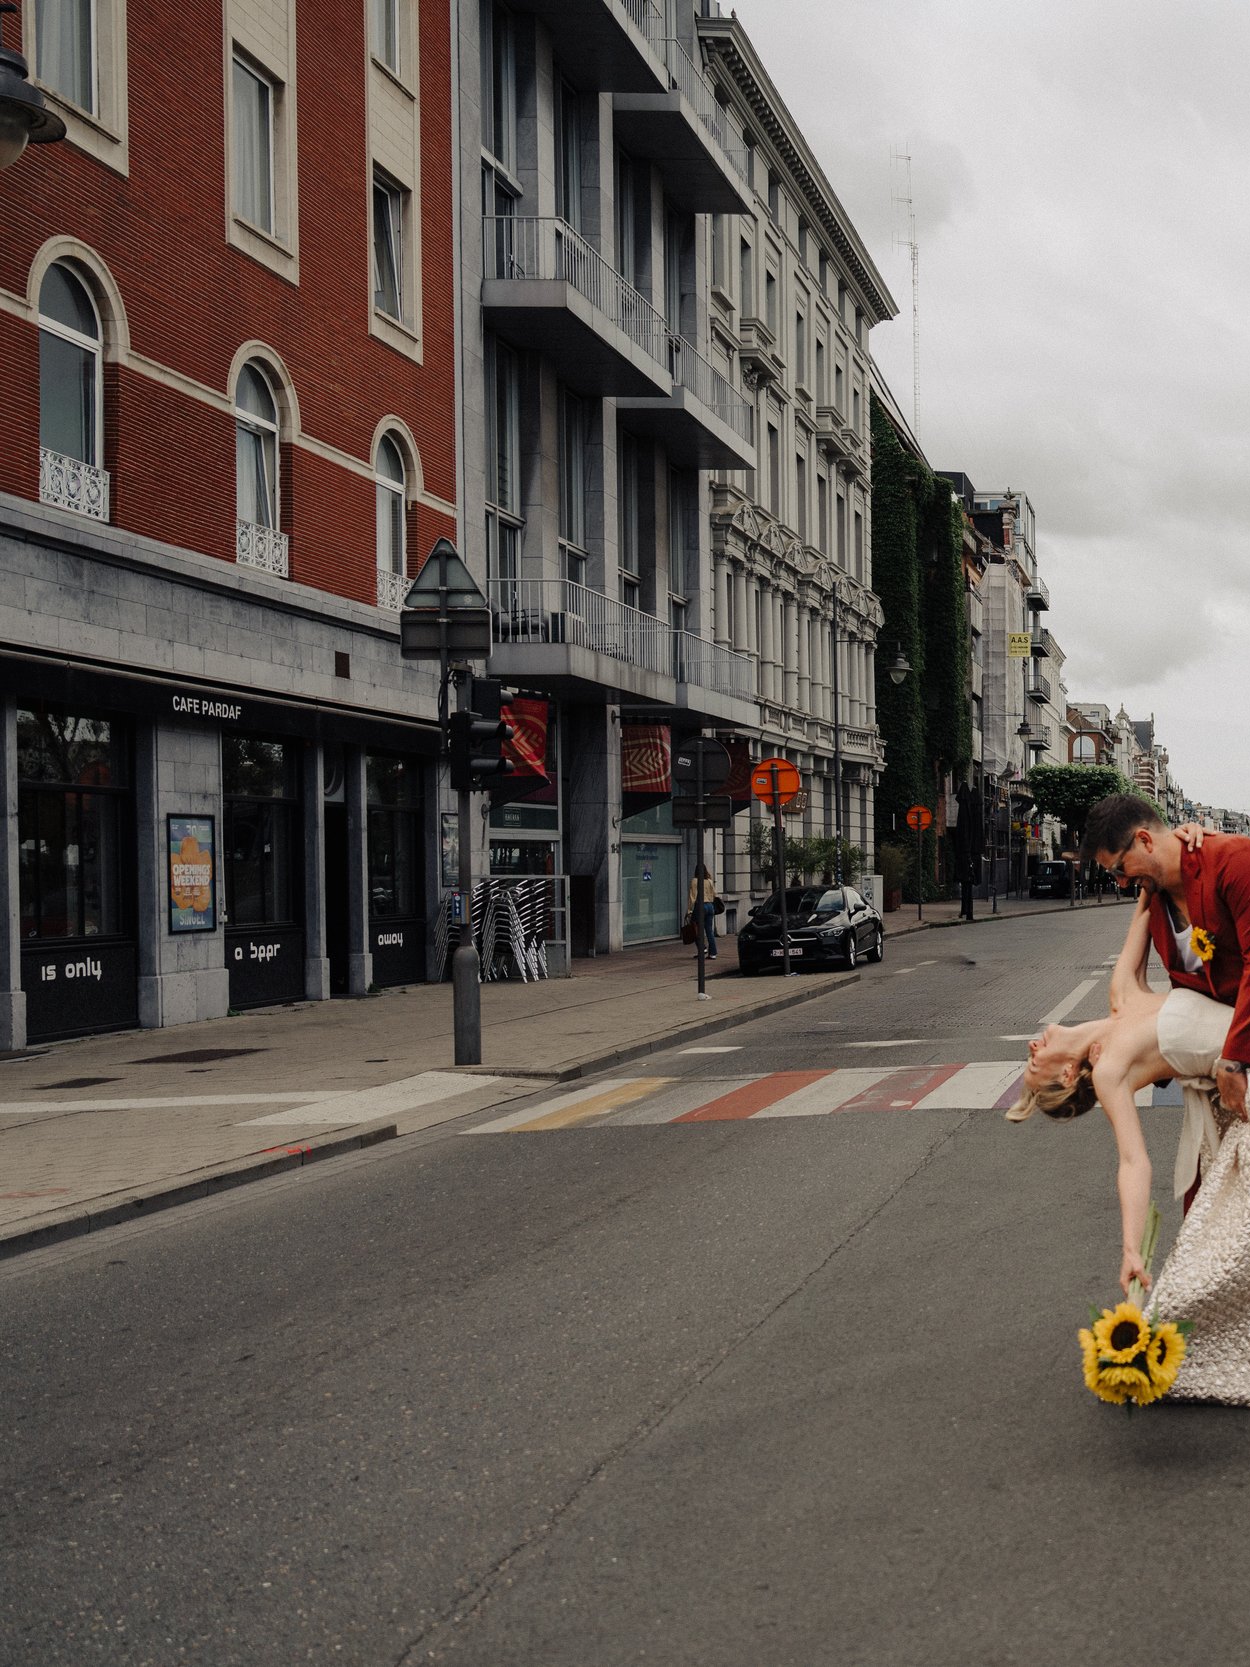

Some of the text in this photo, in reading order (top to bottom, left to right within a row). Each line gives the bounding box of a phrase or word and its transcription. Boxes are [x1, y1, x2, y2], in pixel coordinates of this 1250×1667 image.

[172, 695, 242, 720] CAFE PARDAF
[172, 864, 210, 875] OPENINGS
[173, 875, 210, 886] WEEKEND
[378, 932, 403, 948] away
[234, 946, 243, 960] a
[65, 956, 103, 981] only
